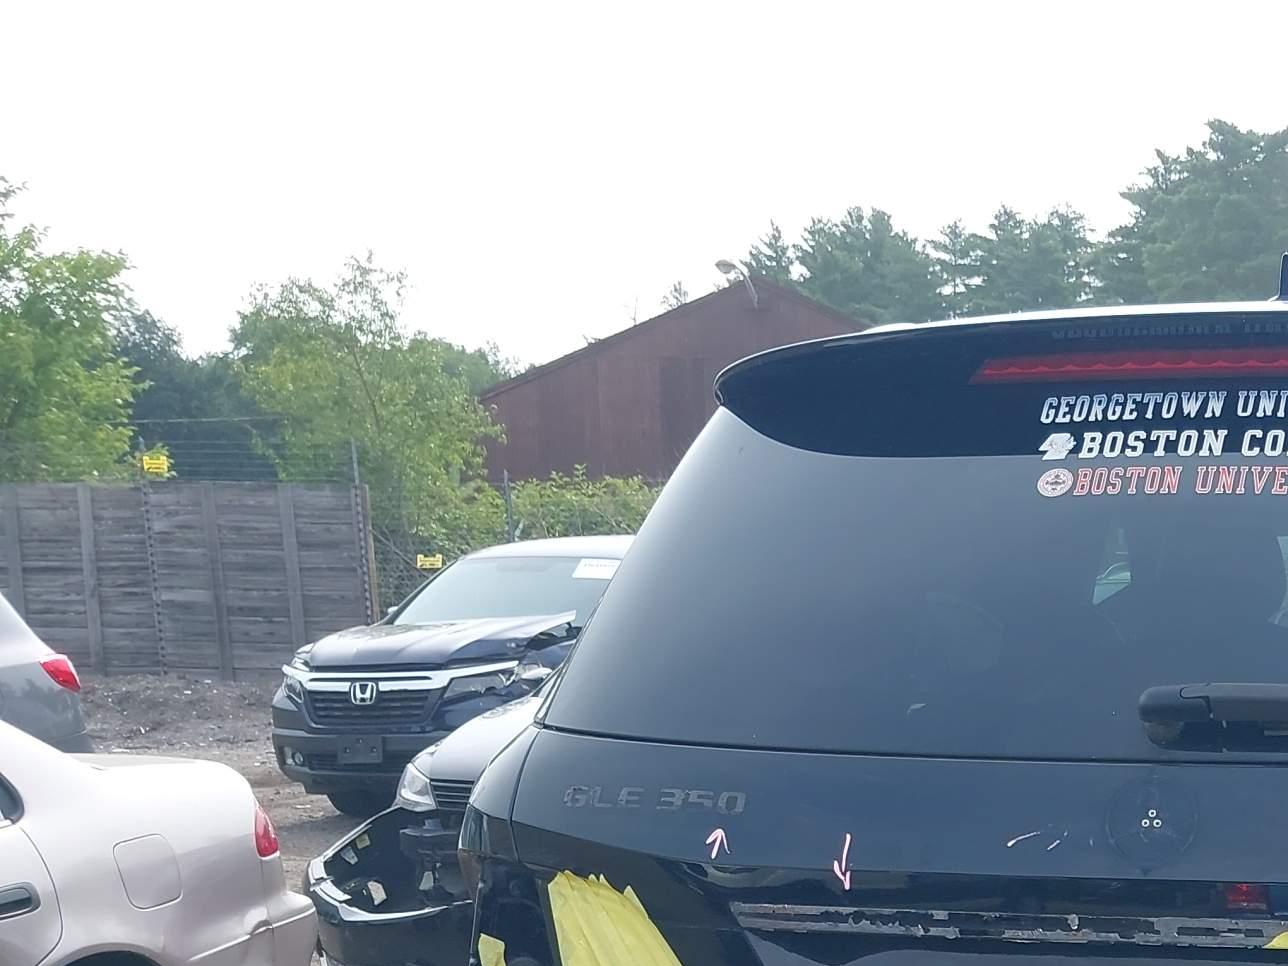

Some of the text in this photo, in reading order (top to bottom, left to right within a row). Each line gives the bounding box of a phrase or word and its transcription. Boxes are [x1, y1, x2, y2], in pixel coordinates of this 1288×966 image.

[1040, 391, 1227, 424] GEORGETOWN
[1078, 430, 1228, 459] BOSTON
[1073, 466, 1183, 496] BOSTON
[563, 785, 645, 808] GLE
